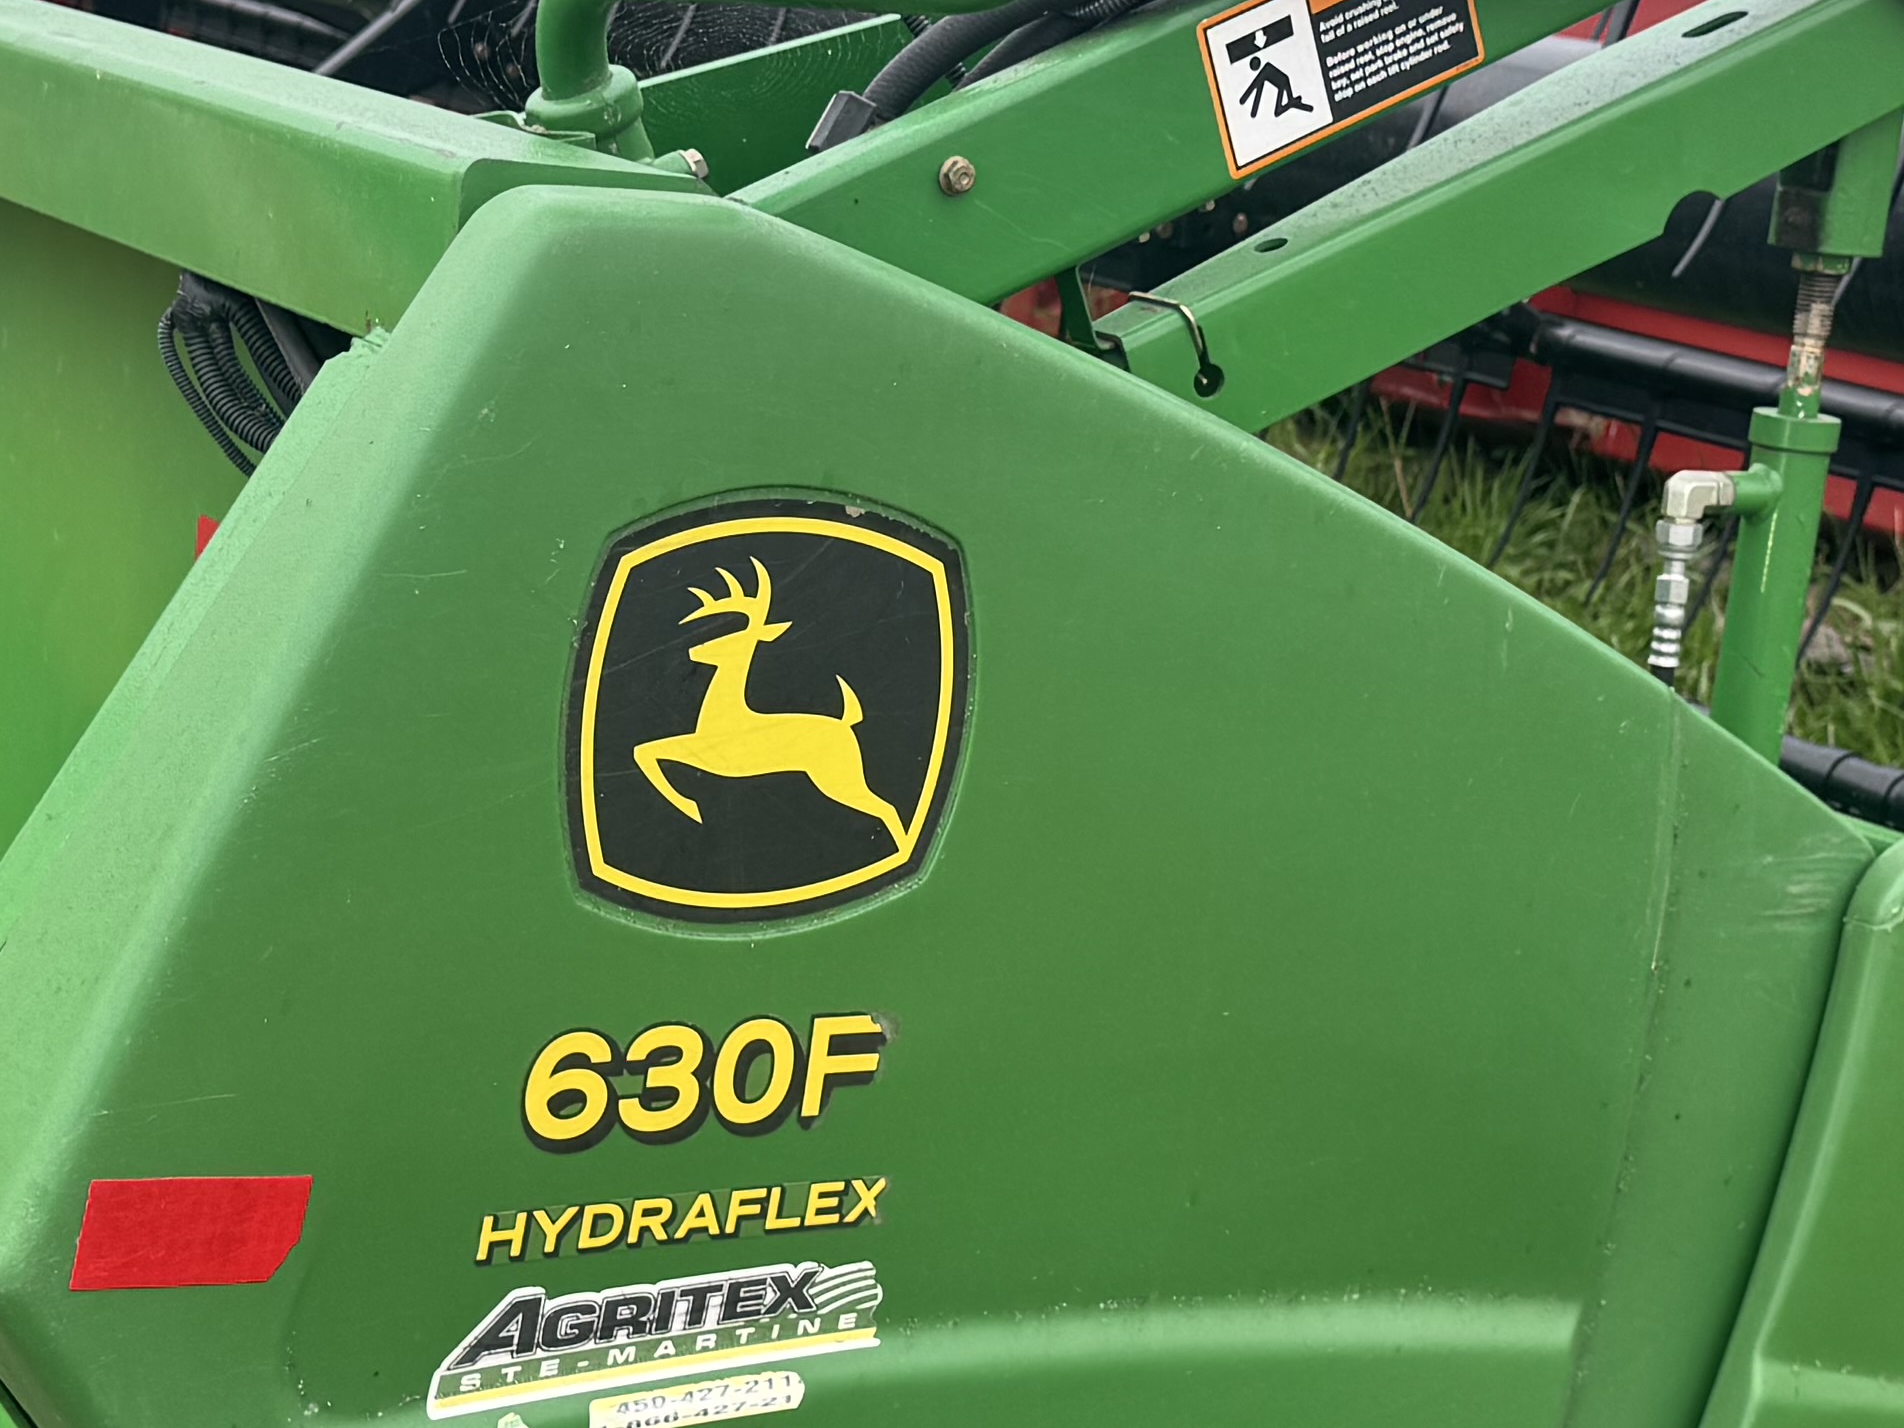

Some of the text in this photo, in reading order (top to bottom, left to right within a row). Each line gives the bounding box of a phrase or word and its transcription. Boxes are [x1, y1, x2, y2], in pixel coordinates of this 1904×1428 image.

[522, 1013, 886, 1151] 630F
[475, 1177, 887, 1264] HYDRAFLEX
[452, 1268, 821, 1370] AGRITEX
[616, 1374, 801, 1414] 450-427-211
